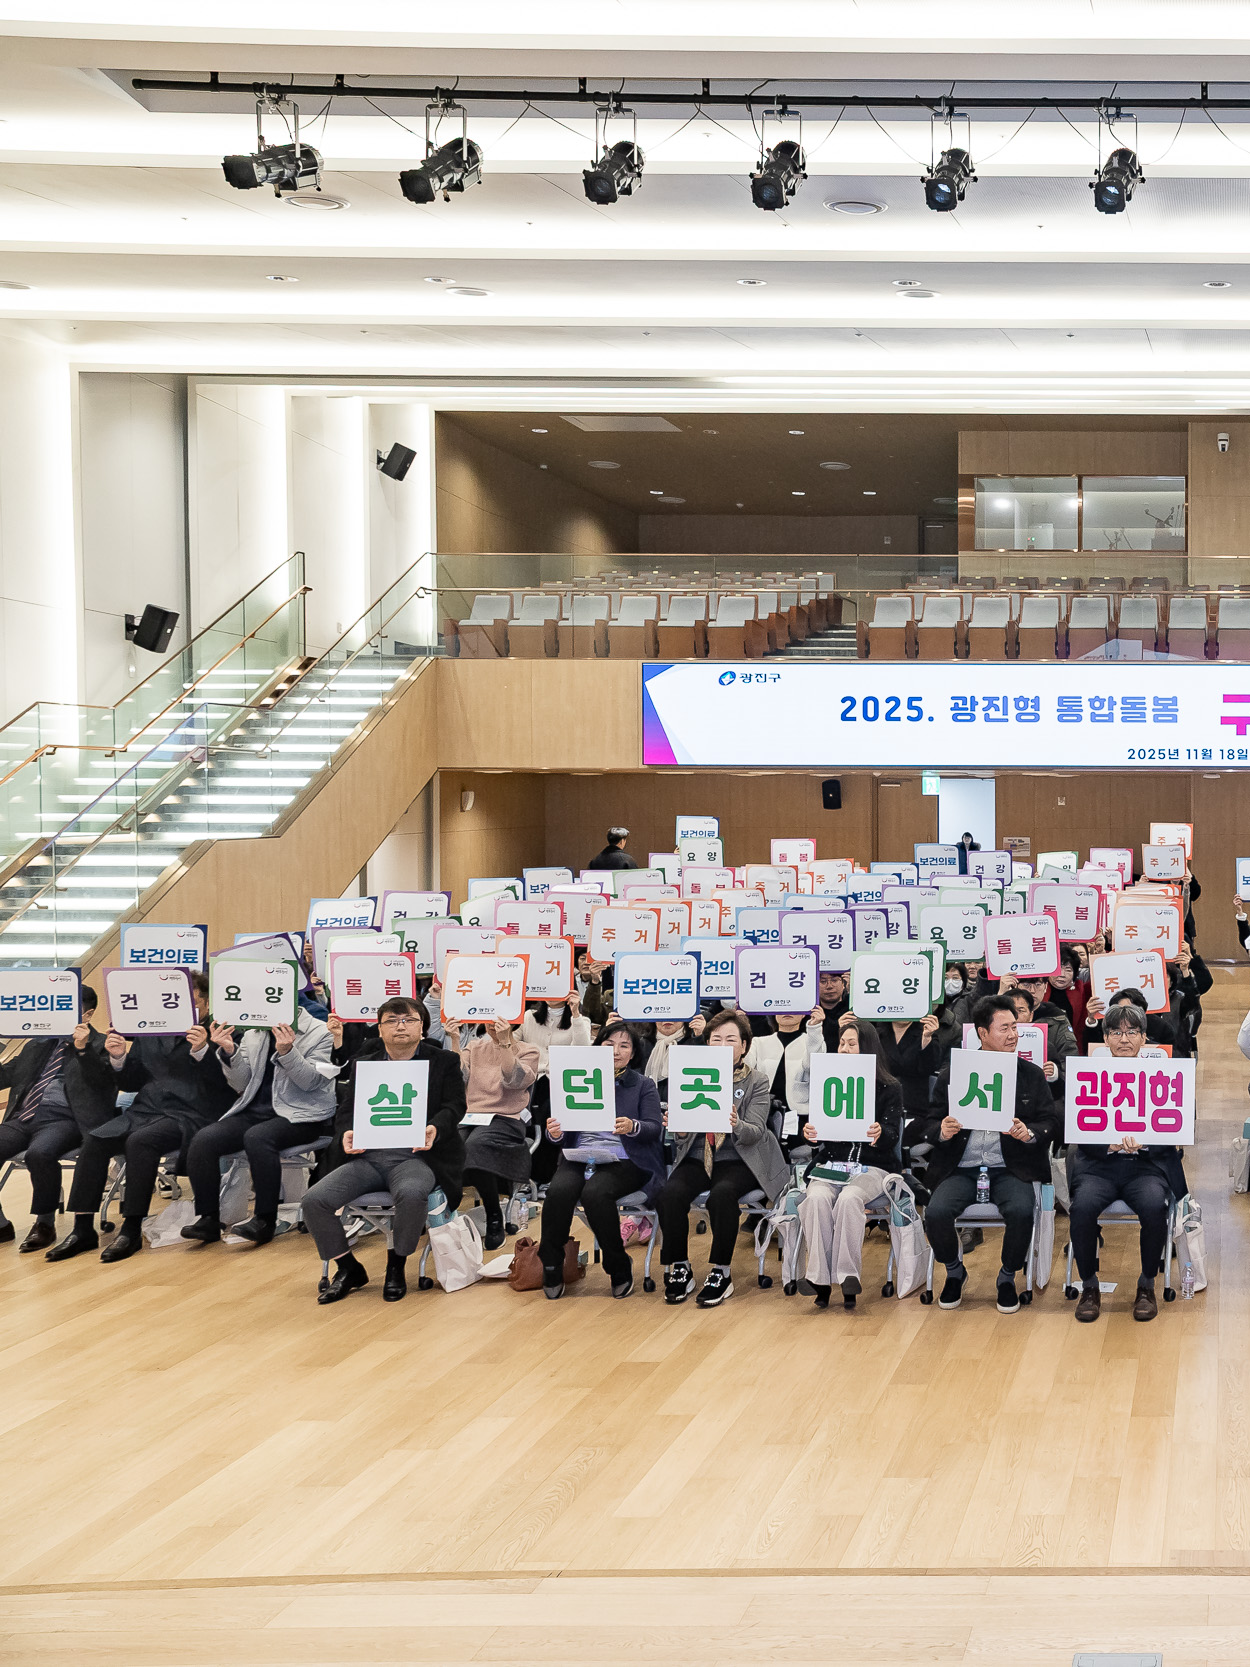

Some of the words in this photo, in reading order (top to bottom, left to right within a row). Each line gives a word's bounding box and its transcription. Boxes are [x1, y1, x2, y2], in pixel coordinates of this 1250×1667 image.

[739, 671, 782, 685] 광진구
[840, 695, 934, 723] 2025.
[949, 695, 1041, 724] 광진형
[1056, 695, 1179, 724] 통합돌봄
[1127, 747, 1180, 761] 2025년
[1185, 747, 1214, 761] 11월
[1218, 747, 1250, 761] 18일
[919, 857, 957, 866] 보건의료
[129, 948, 199, 965] 보건의료
[622, 978, 693, 995] 보건의료
[1, 994, 74, 1012] 보건의료
[562, 1067, 605, 1110] 던
[680, 1067, 722, 1111] 곳
[822, 1076, 866, 1120] 에
[958, 1072, 1003, 1112] 서
[1074, 1070, 1184, 1133] 광진형
[367, 1082, 418, 1127] 살
